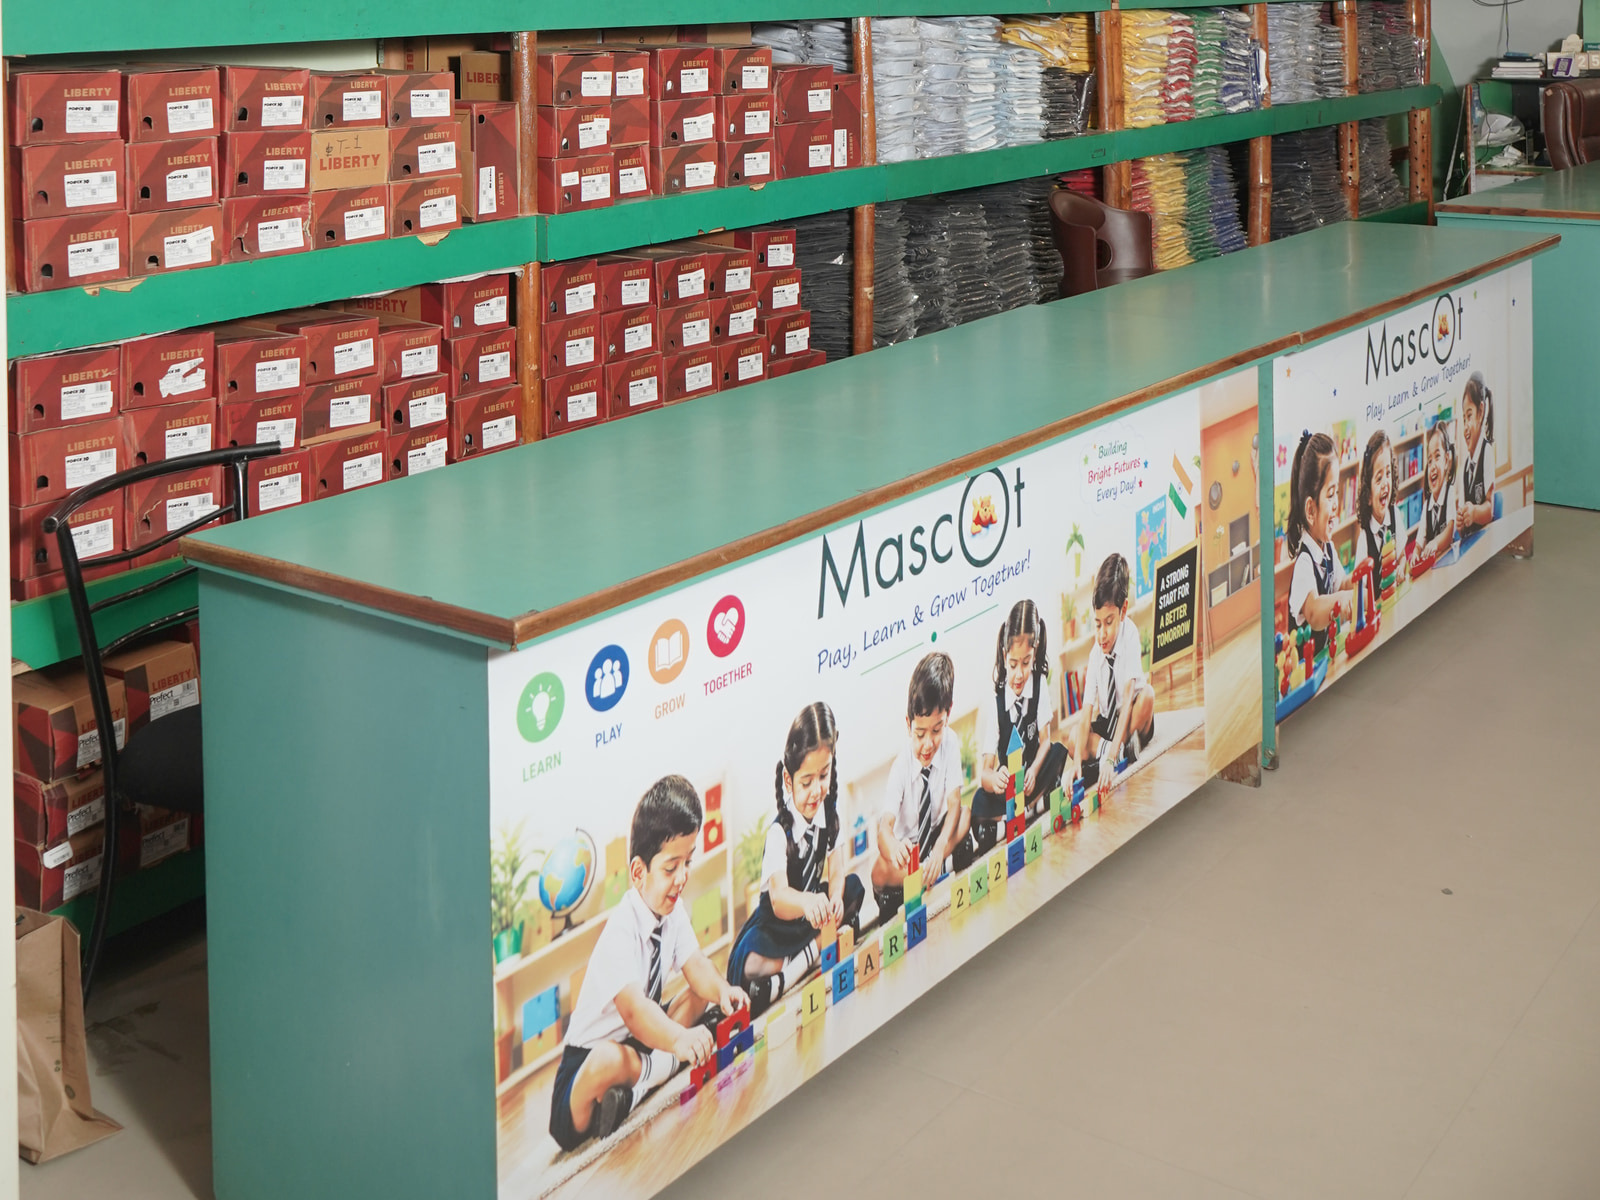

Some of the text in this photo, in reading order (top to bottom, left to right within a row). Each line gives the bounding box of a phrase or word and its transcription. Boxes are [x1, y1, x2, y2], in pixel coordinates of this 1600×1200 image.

[1578, 56, 1586, 67] 2
[1592, 55, 1600, 66] 5
[64, 88, 111, 97] LIBERTY
[169, 85, 211, 96] LIBERTY
[265, 82, 302, 91] LIBERTY
[266, 147, 304, 156] LIBERTY
[65, 158, 112, 169] LIBERTY
[168, 154, 208, 165] LIBERTY
[320, 154, 380, 170] LIBERTY
[582, 165, 608, 175] LIBERTY
[424, 186, 453, 196] LIBERTY
[350, 197, 379, 207] LIBERTY
[263, 206, 302, 217] LIBERTY
[70, 228, 117, 243] LIBERTY
[474, 288, 503, 299] LIBERTY
[337, 329, 368, 340] LIBERTY
[568, 326, 594, 337] LIBERTY
[406, 335, 432, 345] LIBERTY
[482, 341, 510, 353] LIBERTY
[161, 348, 203, 360] LIBERTY
[261, 347, 296, 359] LIBERTY
[62, 368, 108, 384] LIBERTY
[335, 380, 362, 392] LIBERTY
[412, 387, 438, 398] LIBERTY
[570, 379, 596, 392] LIBERTY
[1366, 354, 1471, 422] Play, Learn & Grow Together!
[260, 404, 291, 417] LIBERTY
[484, 400, 514, 414] LIBERTY
[165, 414, 211, 429] LIBERTY
[67, 436, 116, 452] LIBERTY
[347, 440, 378, 455] LIBERTY
[1098, 440, 1128, 459] Building
[265, 461, 298, 476] LIBERTY
[1088, 457, 1141, 484] Bright Futures
[168, 477, 210, 493] LIBERTY
[1096, 476, 1137, 502] Every Day!
[67, 506, 114, 525] LIBERTY
[1160, 564, 1189, 591] A STRONG
[1159, 582, 1190, 610] START FOR
[817, 550, 1032, 674] Play, Learn & Grow Together!
[1160, 603, 1187, 629] A BETTER
[1157, 620, 1190, 648] TOMORROW
[152, 669, 190, 691] LIBERTY
[704, 662, 752, 696] TOGETHER
[150, 690, 173, 705] Prefect
[654, 694, 686, 720] GROW
[595, 723, 623, 748] PLAY
[523, 752, 562, 782] LEARN
[68, 806, 92, 822] Prefect
